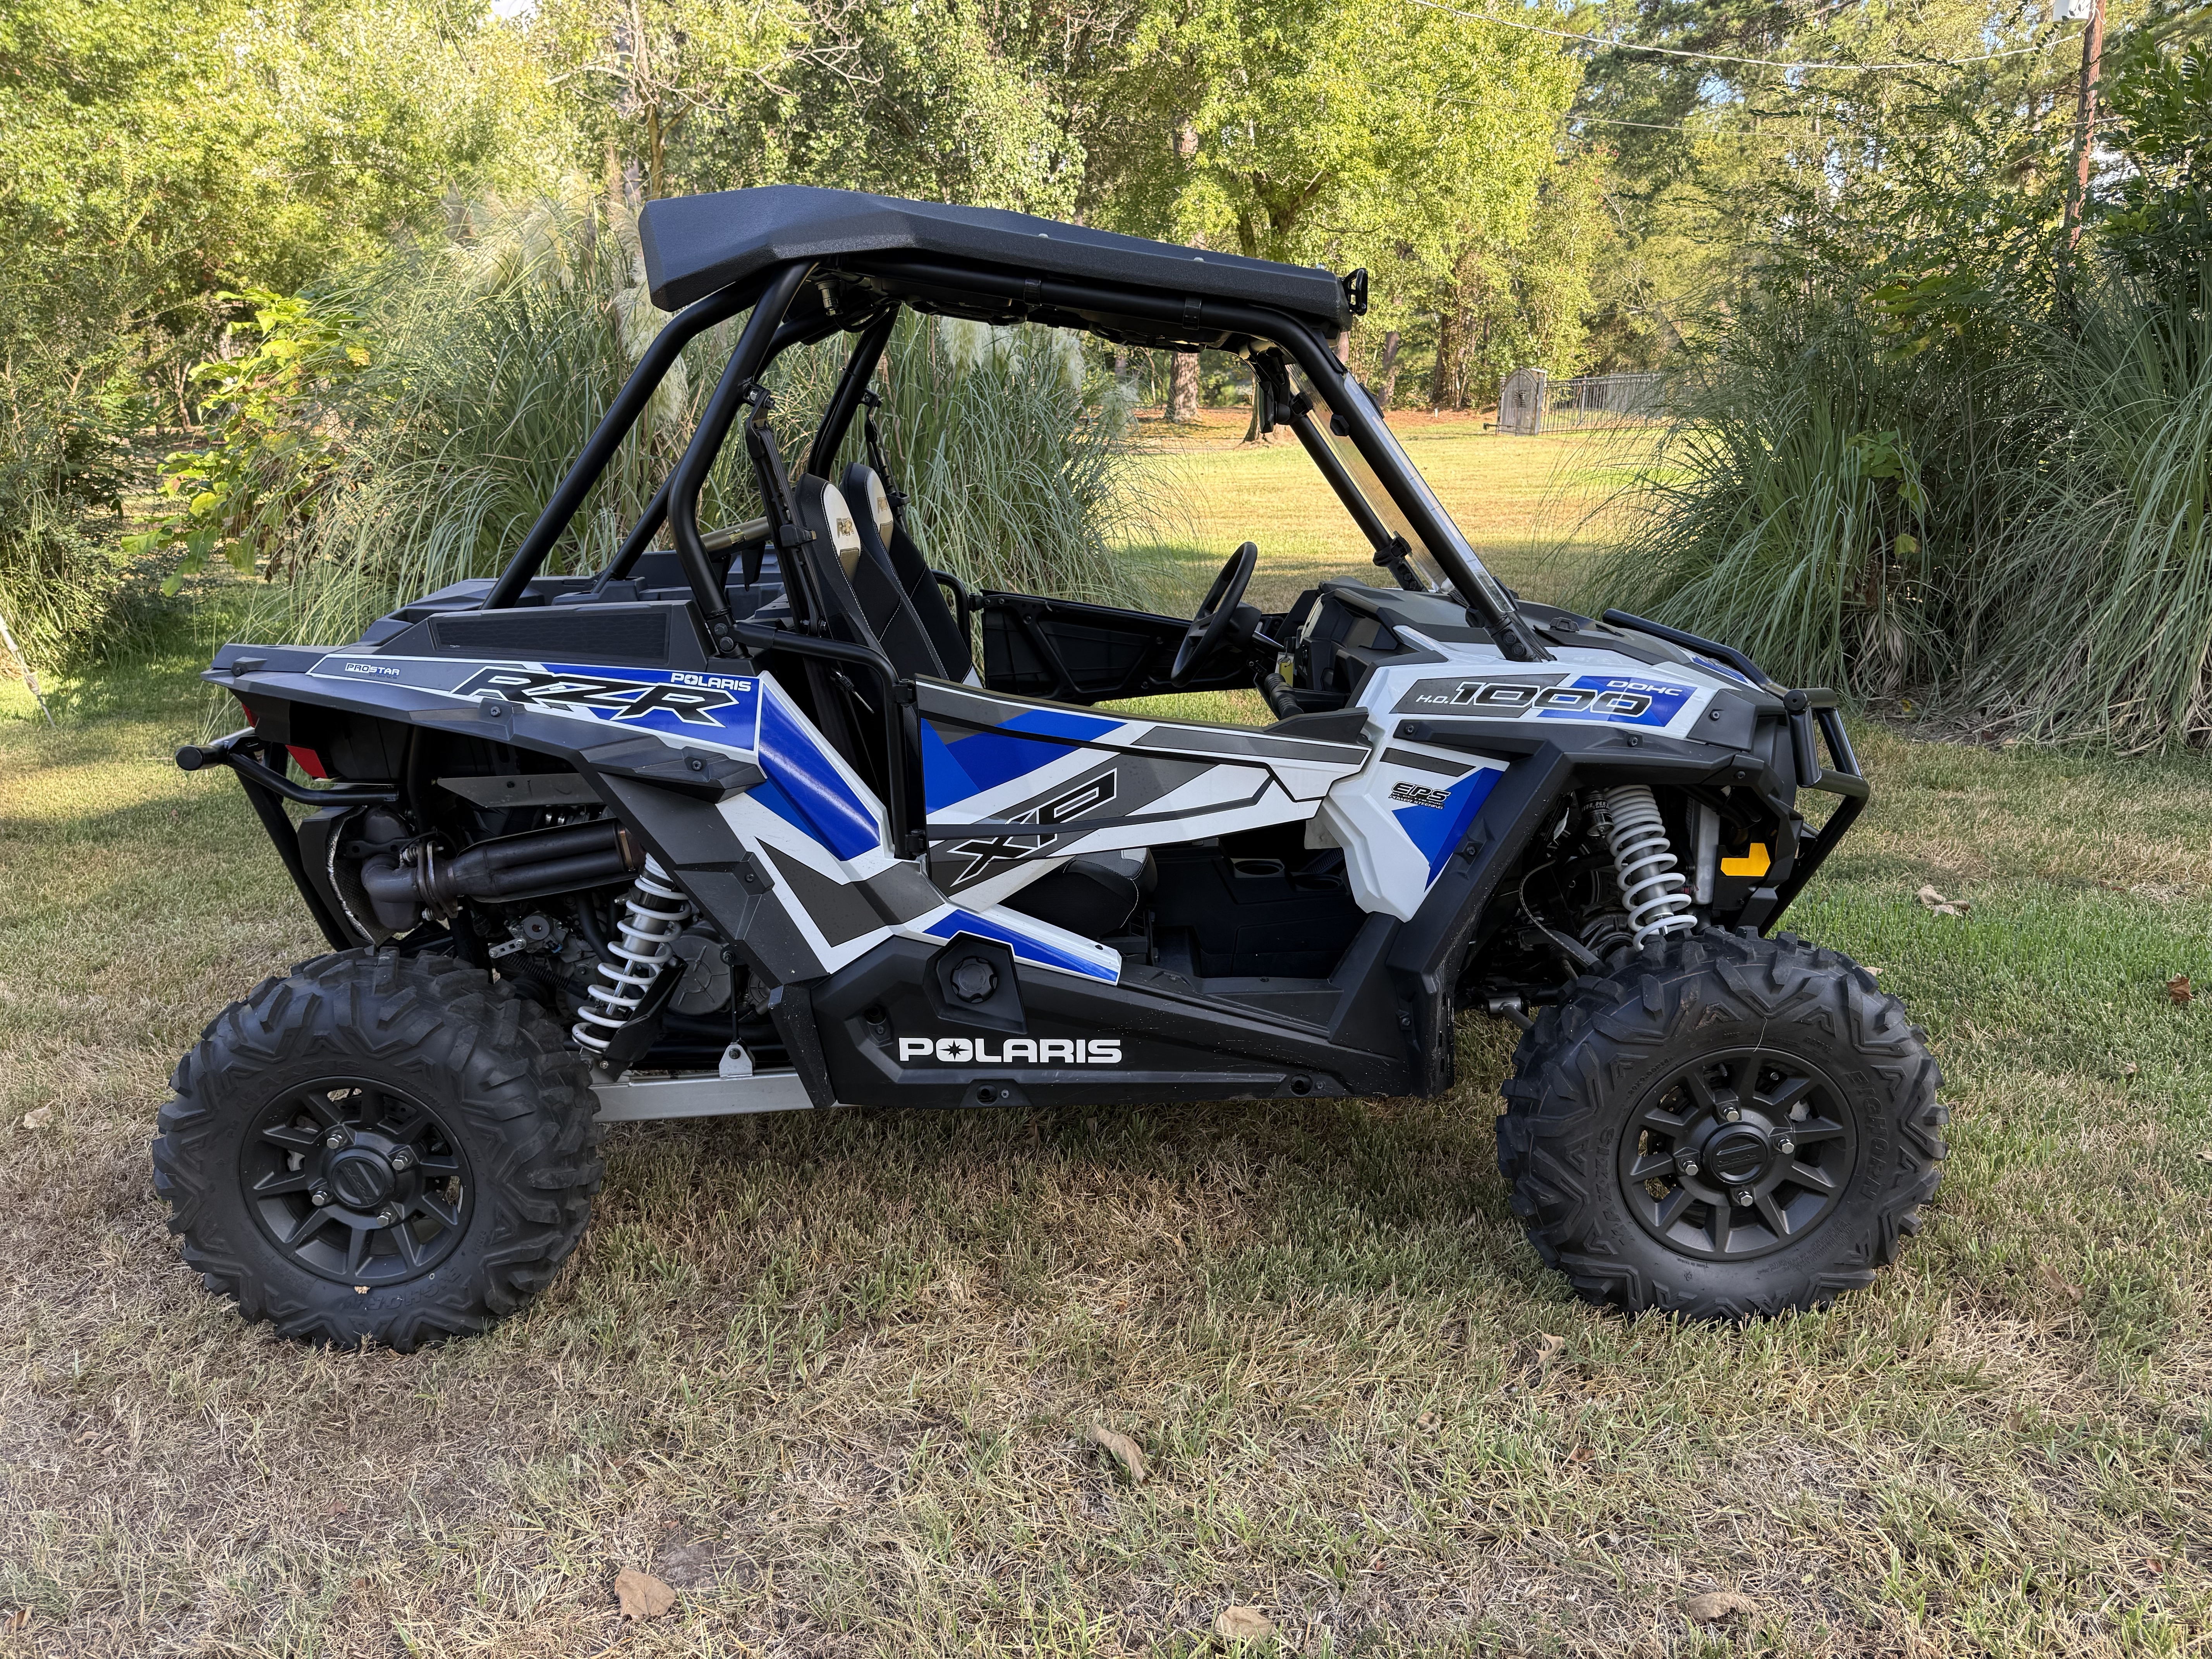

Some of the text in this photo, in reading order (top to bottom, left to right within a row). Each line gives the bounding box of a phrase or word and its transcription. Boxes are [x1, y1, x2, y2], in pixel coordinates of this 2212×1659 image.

[345, 663, 400, 676] PROSTAR
[671, 672, 751, 692] POLARIS
[1607, 680, 1683, 696] DOHC
[448, 666, 740, 728] RZR
[1415, 681, 1652, 717] H.O. 1000
[1391, 781, 1451, 802] EPS
[1392, 793, 1444, 806] ELECTRONIC
[1413, 800, 1443, 810] STEERING
[946, 768, 1117, 887] XP
[898, 1037, 1121, 1063] POLARIS
